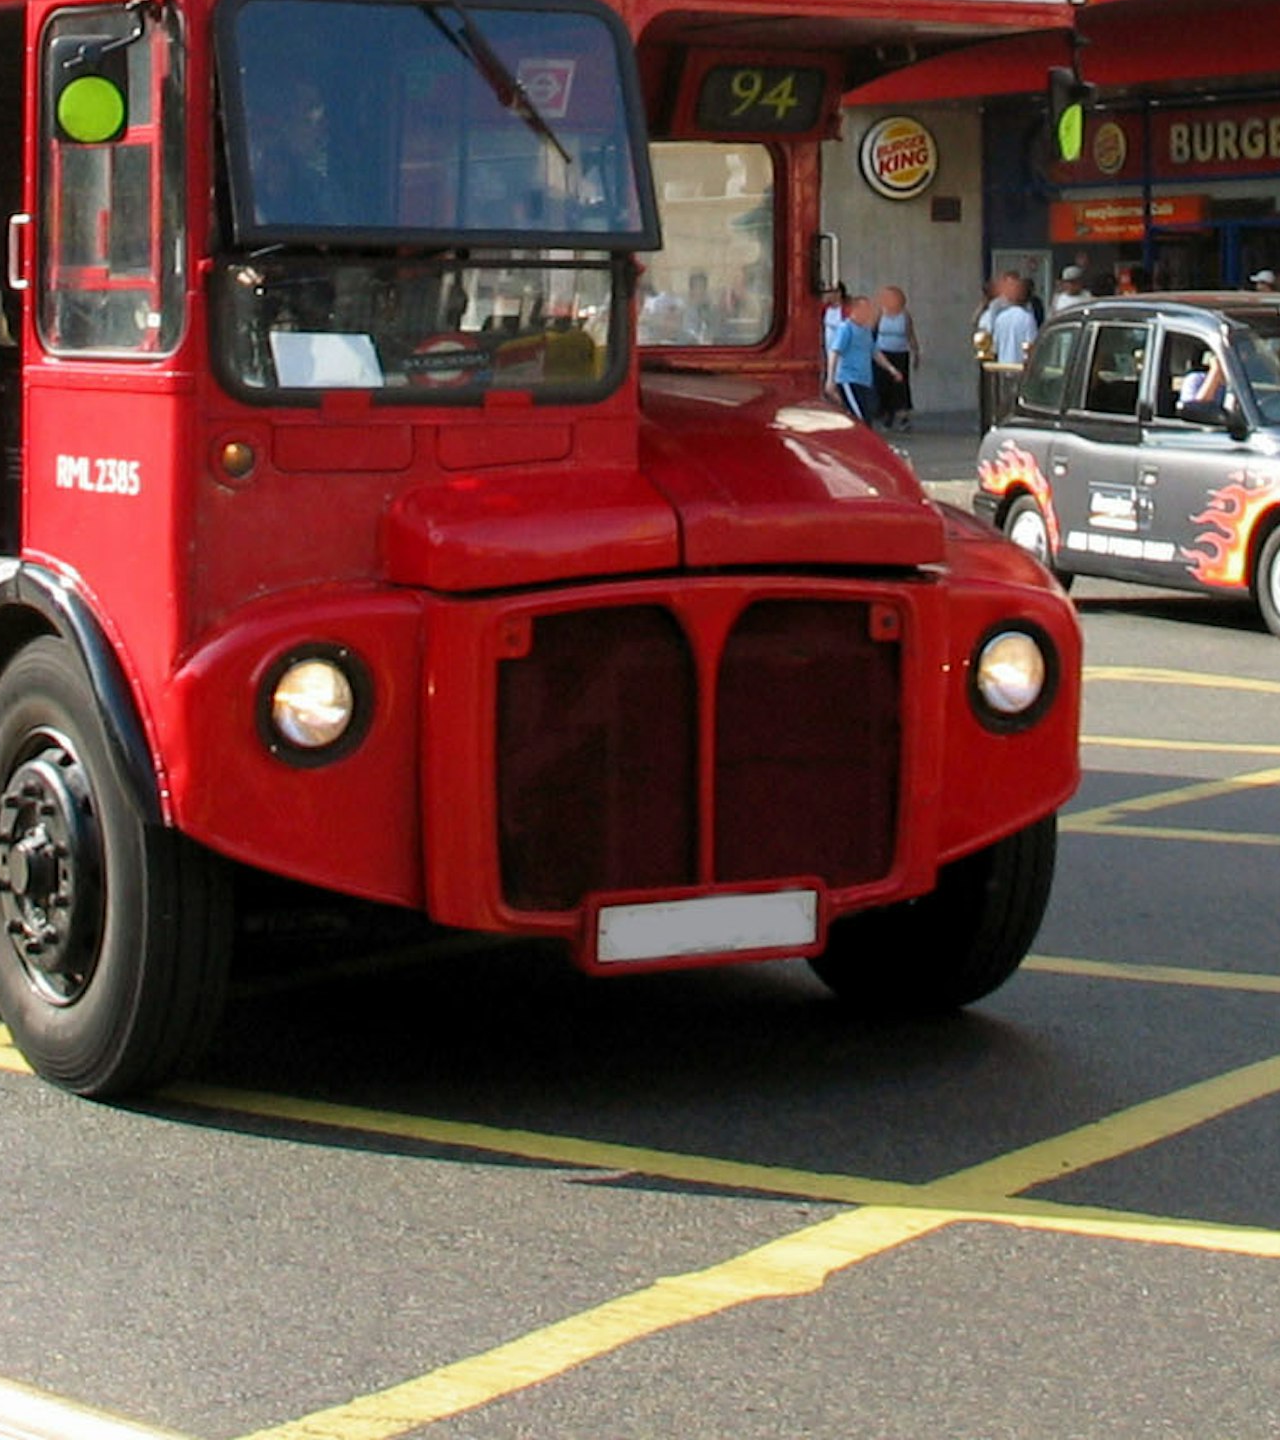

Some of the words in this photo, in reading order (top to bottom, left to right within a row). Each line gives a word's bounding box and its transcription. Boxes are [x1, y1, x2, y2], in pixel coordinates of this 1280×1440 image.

[731, 69, 799, 120] 94
[876, 133, 926, 158] BURGER
[878, 147, 929, 177] KING
